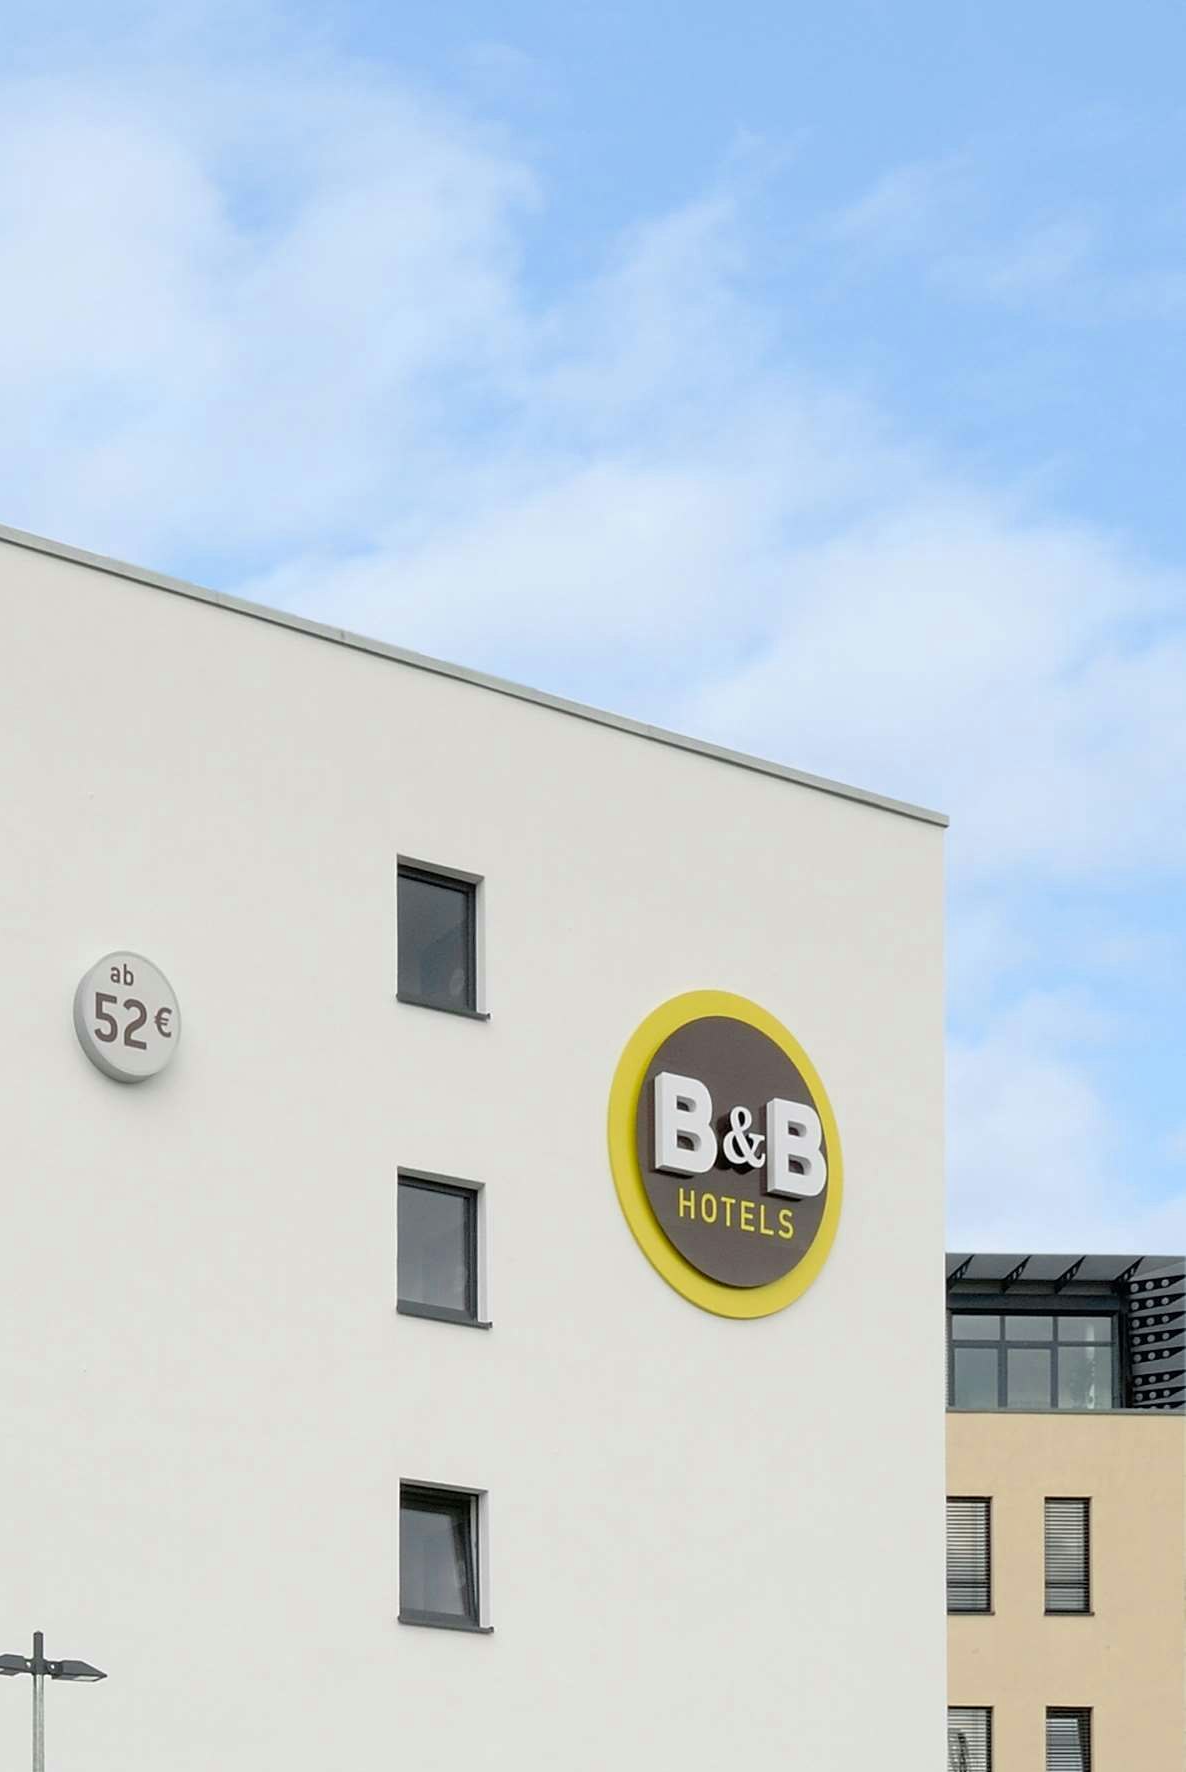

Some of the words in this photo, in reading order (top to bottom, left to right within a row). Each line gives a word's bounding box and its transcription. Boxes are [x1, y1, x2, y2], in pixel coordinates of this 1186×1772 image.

[110, 963, 135, 986] ab
[94, 991, 172, 1050] 52€
[655, 1071, 827, 1197] B&B
[678, 1187, 794, 1239] HOTELS
